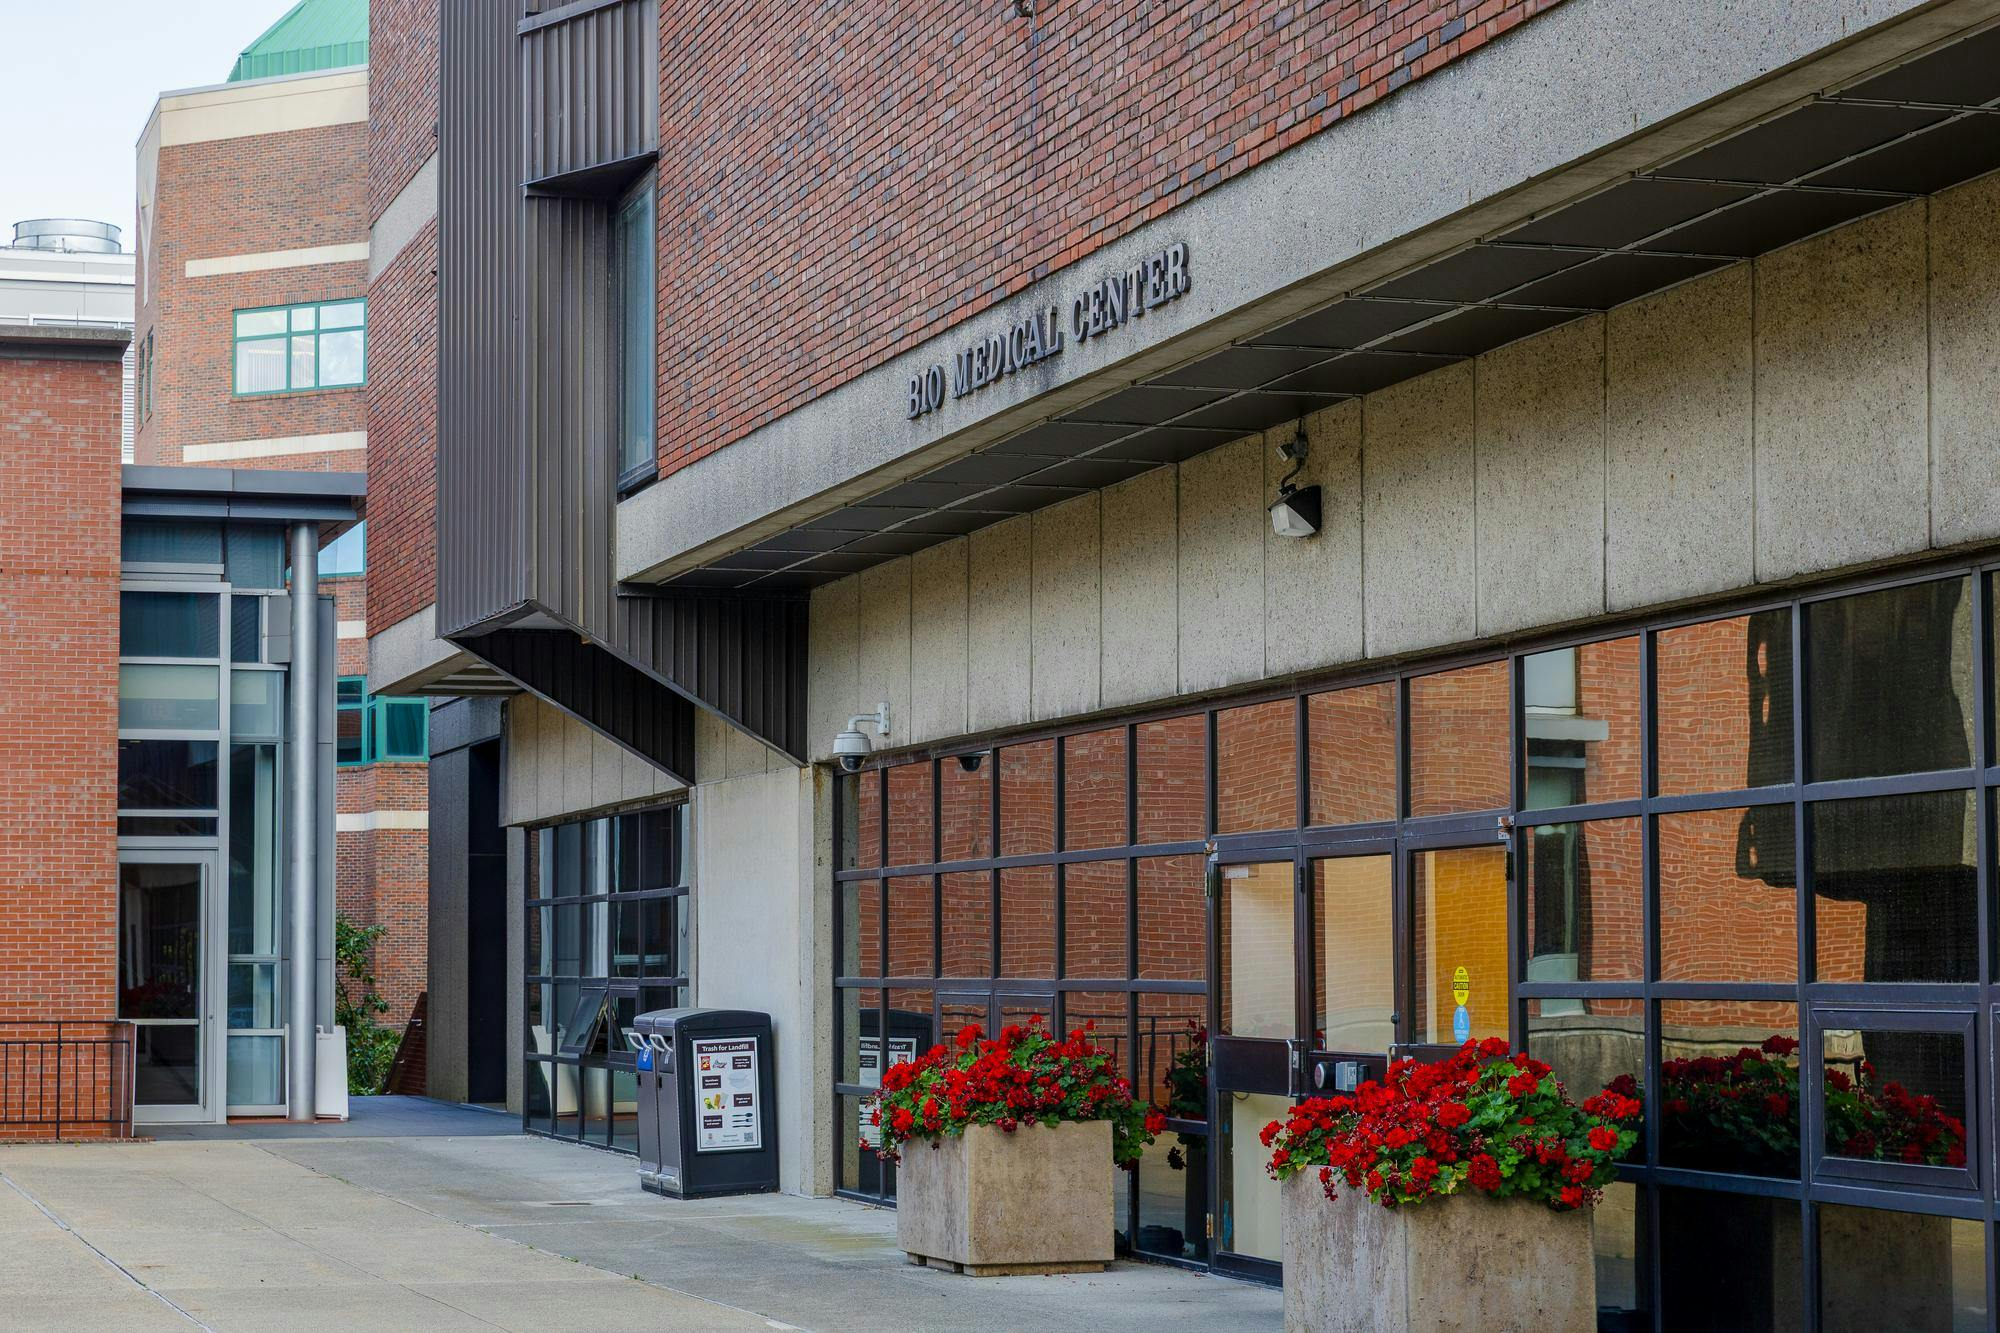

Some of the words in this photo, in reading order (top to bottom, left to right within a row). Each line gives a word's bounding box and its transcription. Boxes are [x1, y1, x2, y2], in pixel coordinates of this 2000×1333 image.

[907, 364, 945, 420] BIO
[951, 305, 1064, 399] MEDICAL
[1070, 242, 1192, 343] CENTER
